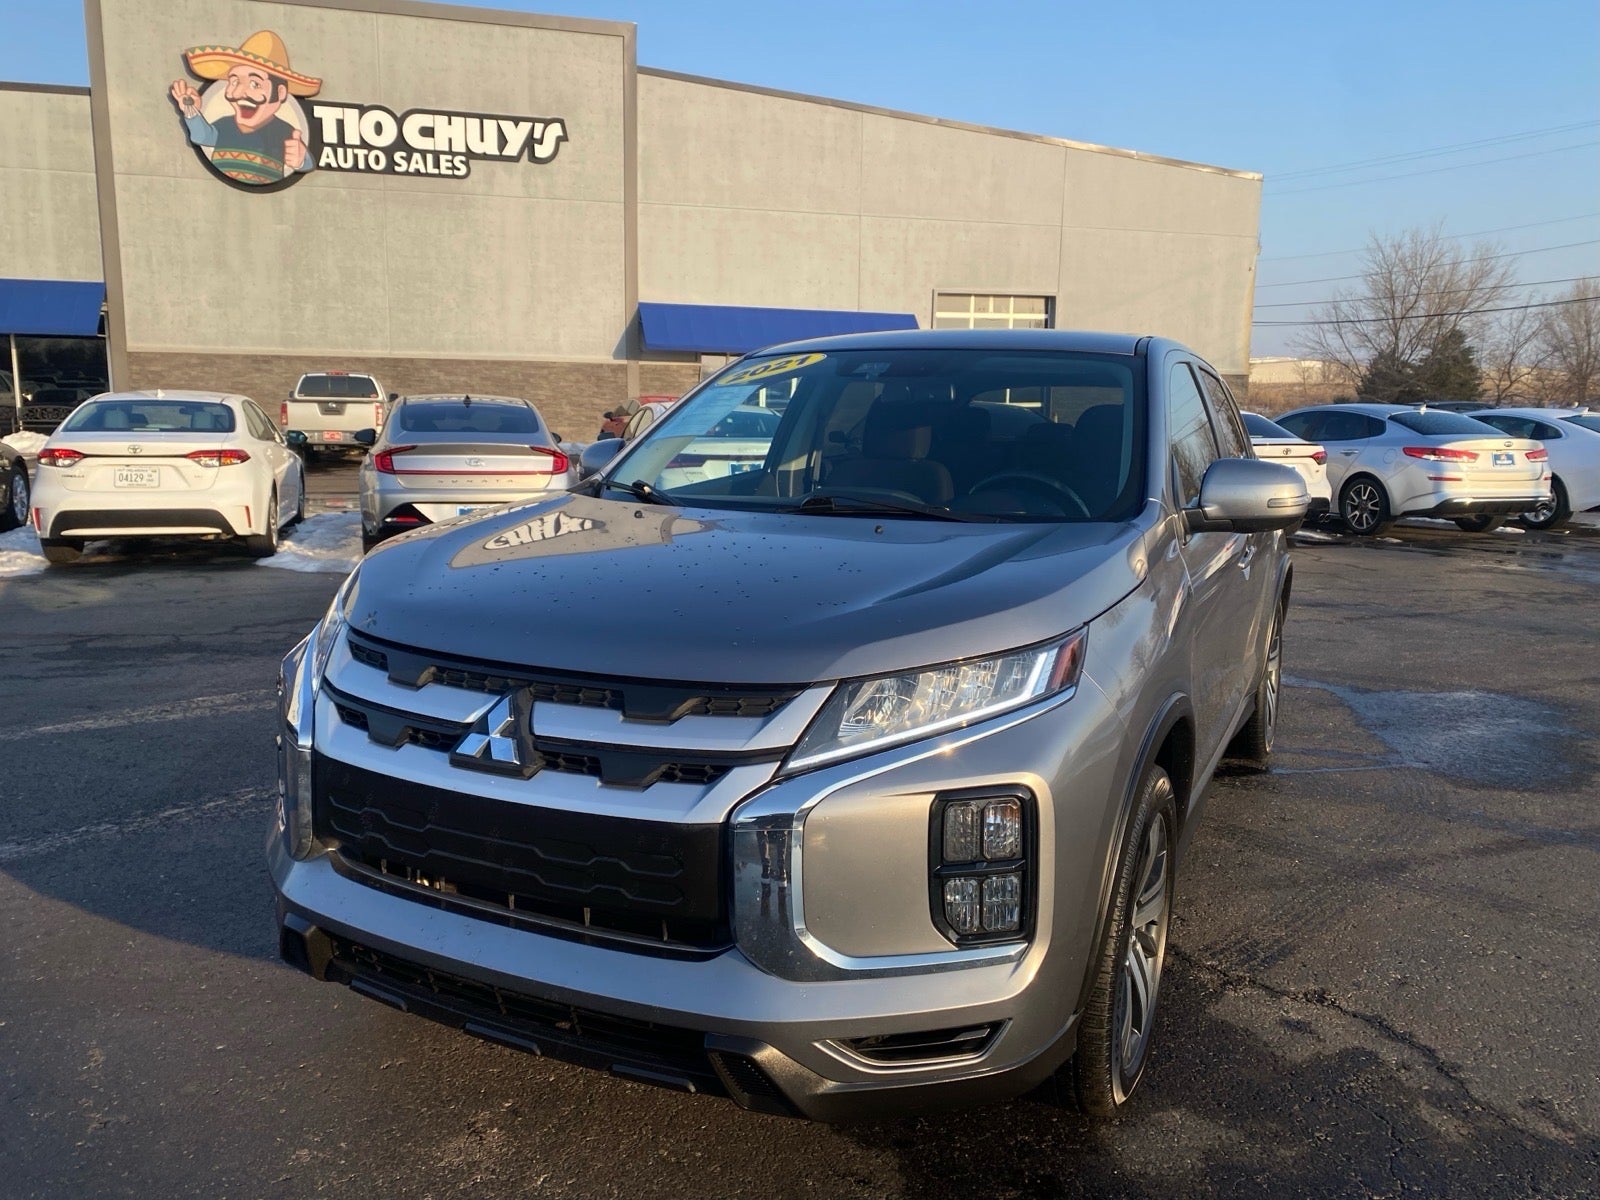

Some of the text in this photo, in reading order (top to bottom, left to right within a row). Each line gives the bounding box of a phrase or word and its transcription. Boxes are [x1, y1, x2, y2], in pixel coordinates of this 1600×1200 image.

[313, 105, 563, 158] TIO CHUY'S
[319, 146, 467, 176] AUTO SALES
[725, 355, 812, 383] 2021
[118, 473, 144, 482] 04129
